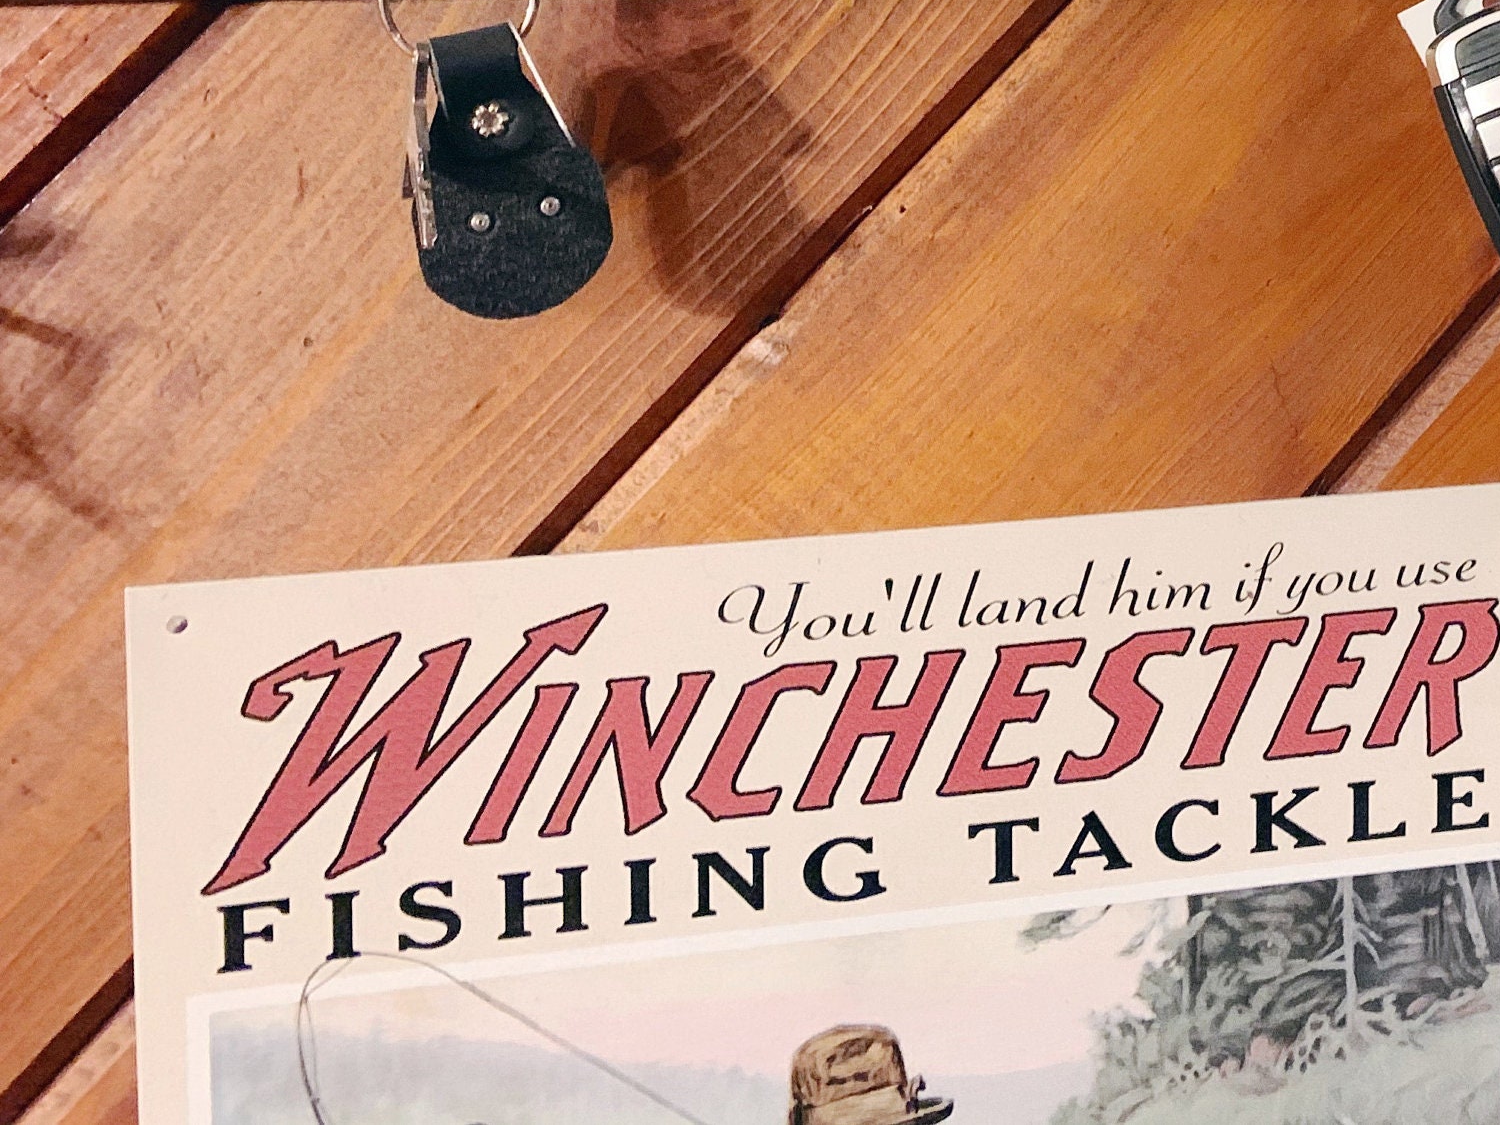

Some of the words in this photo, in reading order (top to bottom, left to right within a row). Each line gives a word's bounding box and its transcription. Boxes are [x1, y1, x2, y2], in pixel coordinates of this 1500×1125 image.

[717, 572, 943, 658] You'll
[958, 559, 1095, 628] land
[1108, 556, 1212, 617] him
[1234, 541, 1285, 616] if
[1276, 566, 1377, 614] you
[1396, 558, 1478, 587] use
[216, 835, 887, 974] FISHING
[967, 768, 1491, 886] TACKLE
